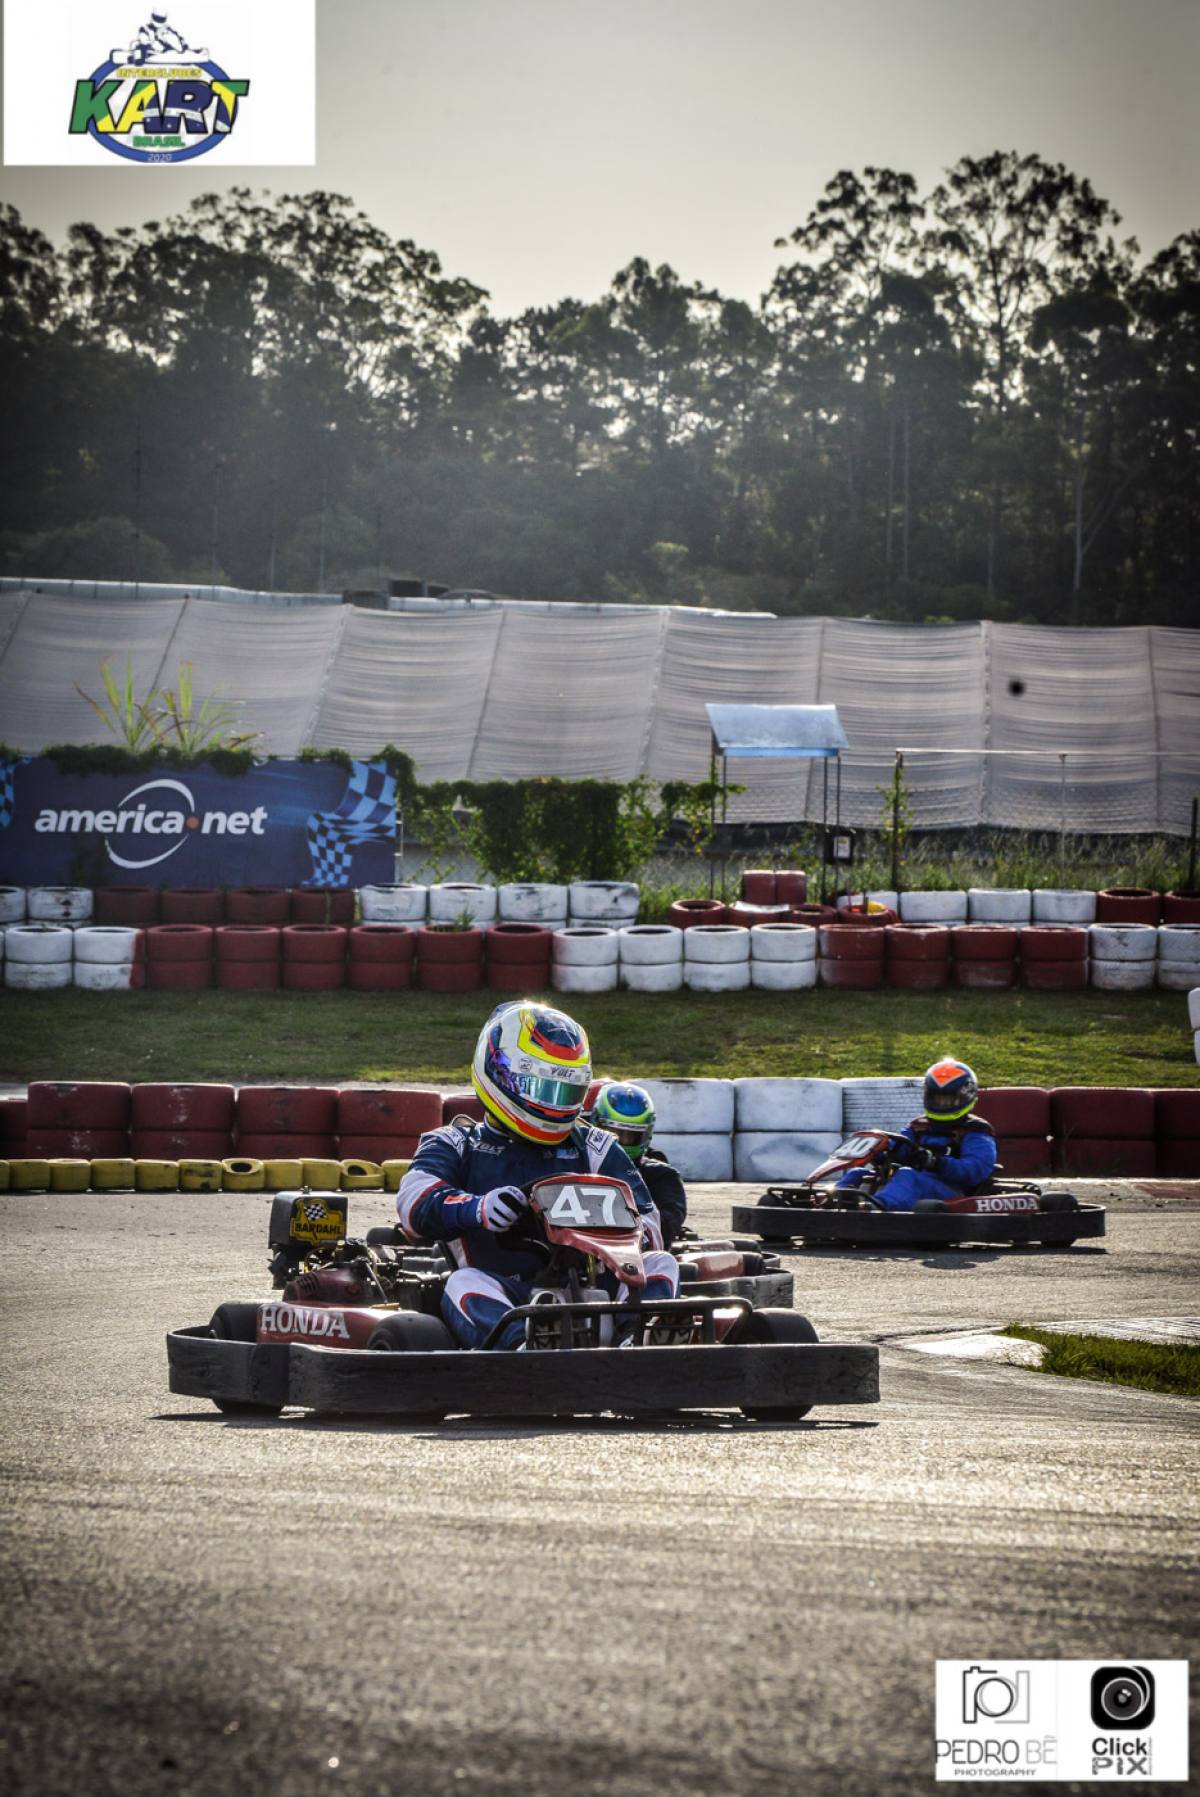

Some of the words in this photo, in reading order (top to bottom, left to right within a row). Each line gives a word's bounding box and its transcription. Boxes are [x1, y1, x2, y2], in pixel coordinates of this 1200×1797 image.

[550, 1185, 617, 1225] 47
[976, 1198, 1038, 1212] HONDA
[295, 1223, 342, 1233] BARDAHL
[260, 1306, 350, 1338] HONDA
